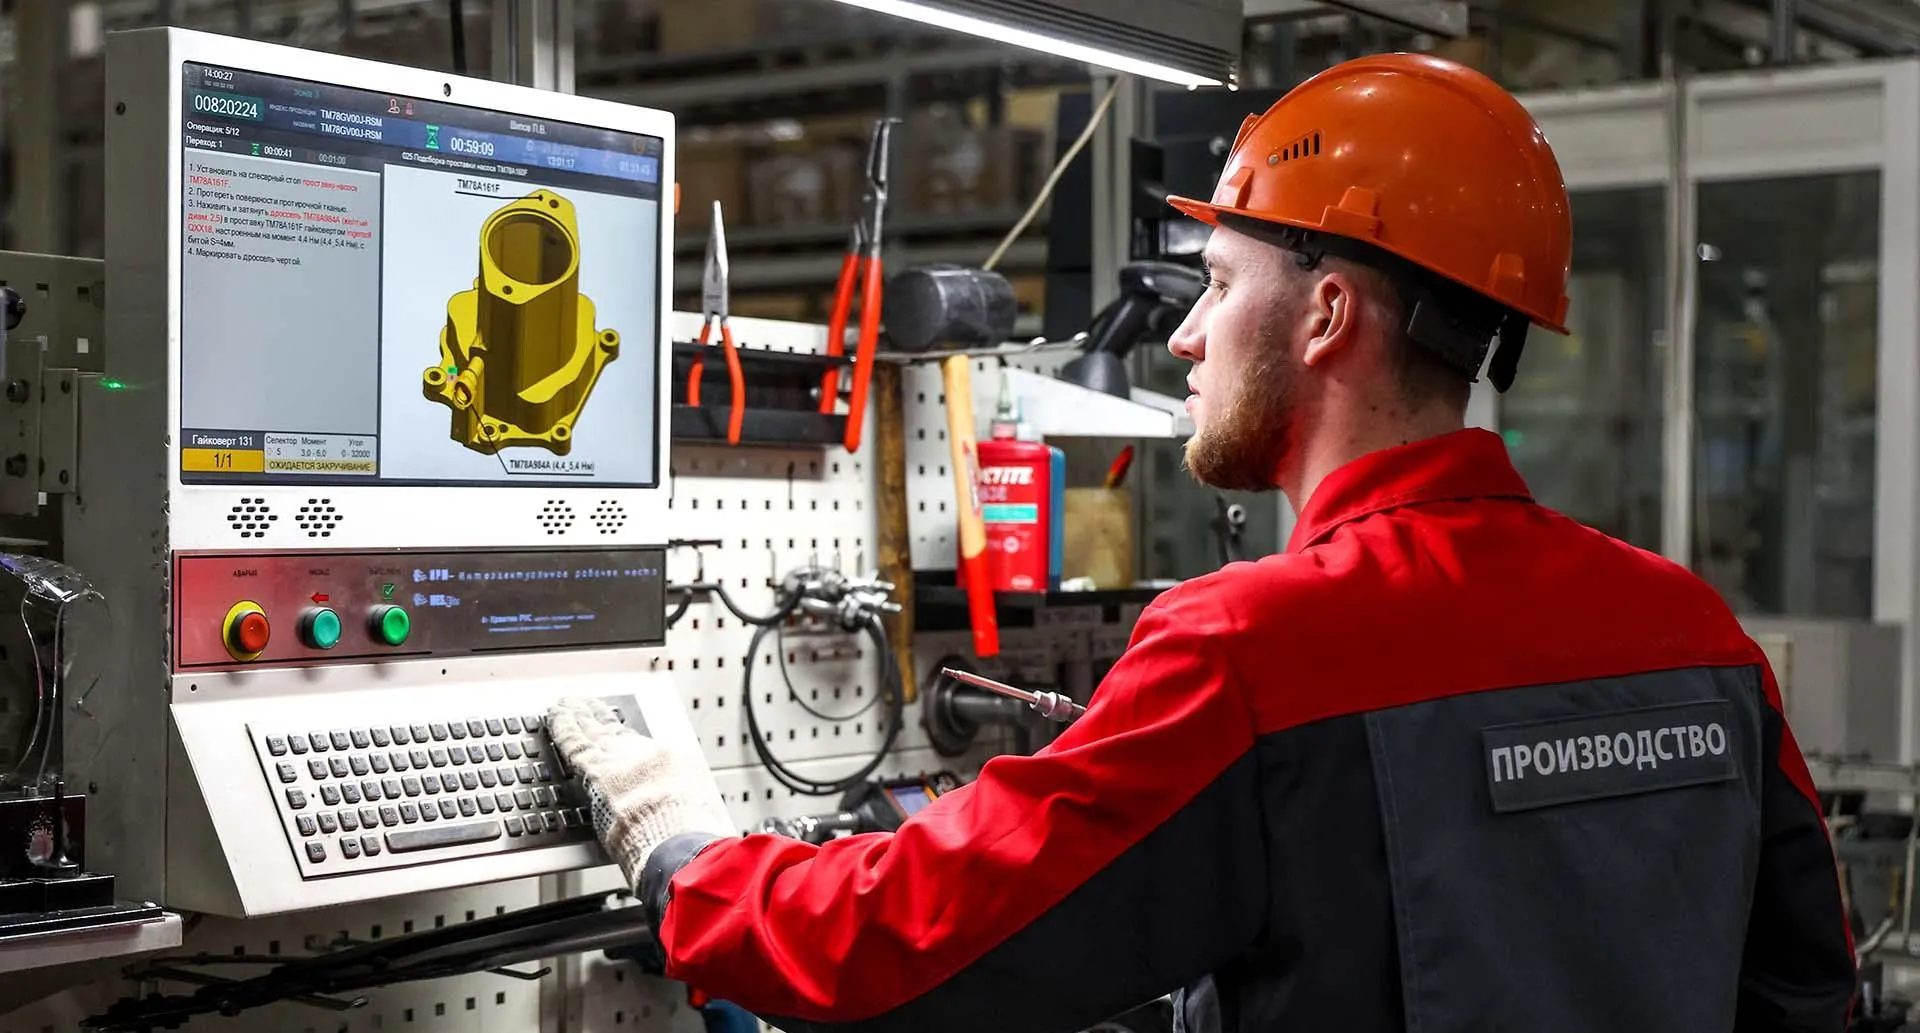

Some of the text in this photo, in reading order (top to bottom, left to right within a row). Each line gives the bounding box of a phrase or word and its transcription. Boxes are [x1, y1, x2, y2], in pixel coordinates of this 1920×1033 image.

[204, 69, 233, 81] 14:00:27
[195, 95, 258, 118] 00820224
[320, 109, 382, 127] TM78GV00J-RSM
[187, 121, 240, 136] Операция: 5/12
[320, 122, 382, 140] TM78GV00J-RSM
[186, 135, 223, 148] Переход: 1
[450, 137, 494, 157] 00:59:09
[264, 146, 292, 158] 00:00:41
[401, 151, 413, 161] 025
[477, 164, 496, 172] насоса
[189, 163, 195, 172] 1.
[196, 164, 237, 177] Установить
[248, 172, 285, 182] слесарный
[286, 177, 301, 185] стол
[457, 179, 501, 193] TM78A161F
[188, 187, 348, 213] 2. Протереть поверхности протирочной тканью.
[188, 199, 195, 208] 3.
[196, 200, 231, 211] Наживить
[238, 206, 268, 216] затянуть
[229, 217, 265, 228] проставку
[266, 219, 303, 231] TM78A161F
[304, 225, 345, 236] гайковертом
[188, 235, 209, 246] битой
[215, 228, 261, 238] настроенным
[272, 234, 296, 242] момент
[188, 247, 194, 255] 4.
[196, 248, 241, 260] Маркировать
[243, 254, 275, 263] дроссель
[192, 434, 253, 448] Гайковерт 131
[266, 435, 297, 445] Селектор
[301, 437, 327, 445] Момент
[348, 439, 364, 447] Угол
[276, 448, 281, 456] 5
[352, 450, 370, 458] 32000
[214, 453, 232, 468] 1/1
[269, 461, 371, 472] ОЖИДАЕТСЯ ЗАКРУЧИВАНИЕ
[980, 466, 1034, 485] CTITE
[1492, 723, 1726, 782] ПРОИЗВОДСТВО
